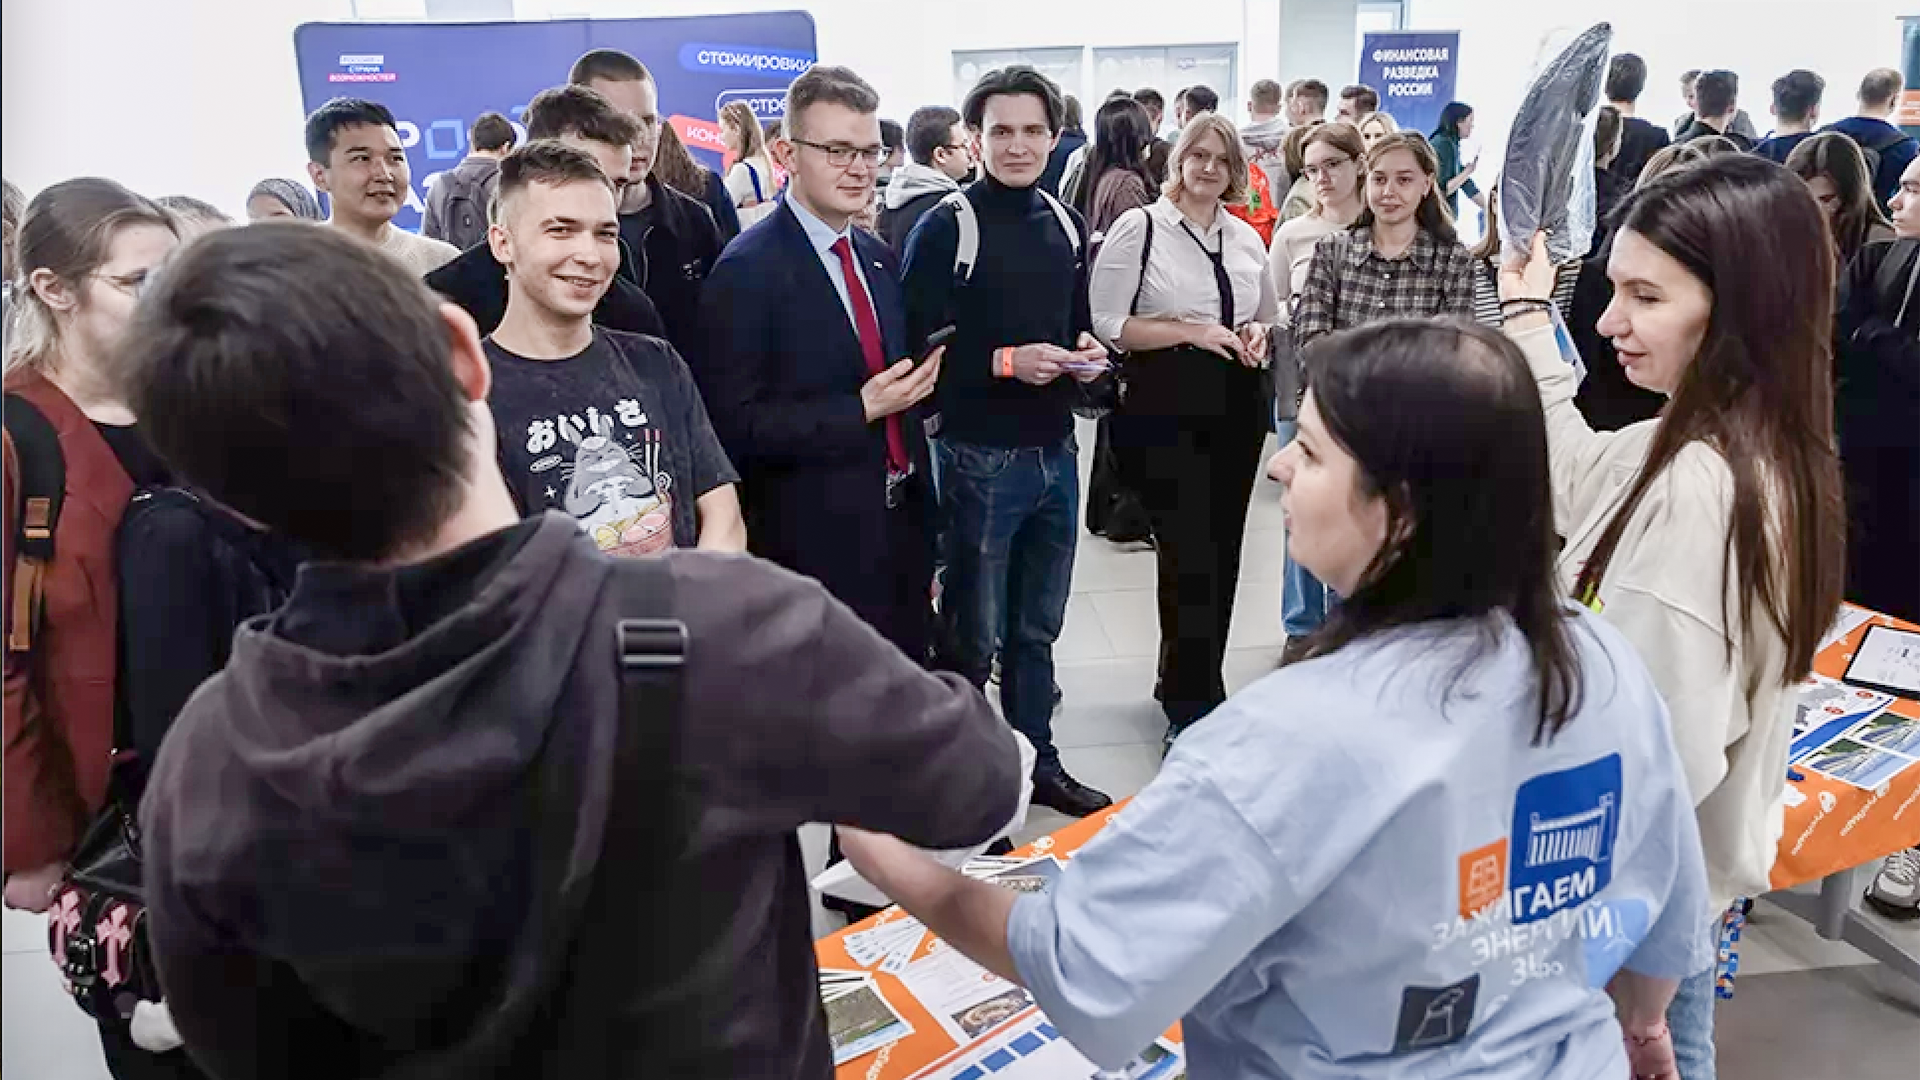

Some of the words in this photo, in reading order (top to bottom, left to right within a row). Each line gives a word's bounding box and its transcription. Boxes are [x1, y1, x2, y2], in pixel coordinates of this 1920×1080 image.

[1372, 47, 1449, 62] ФИНАНСОВАЯ
[1383, 65, 1439, 81] РАЗВЕДКА
[1388, 82, 1433, 97] РОССИИ
[1431, 865, 1597, 951] ЗАЖИГАЕМ
